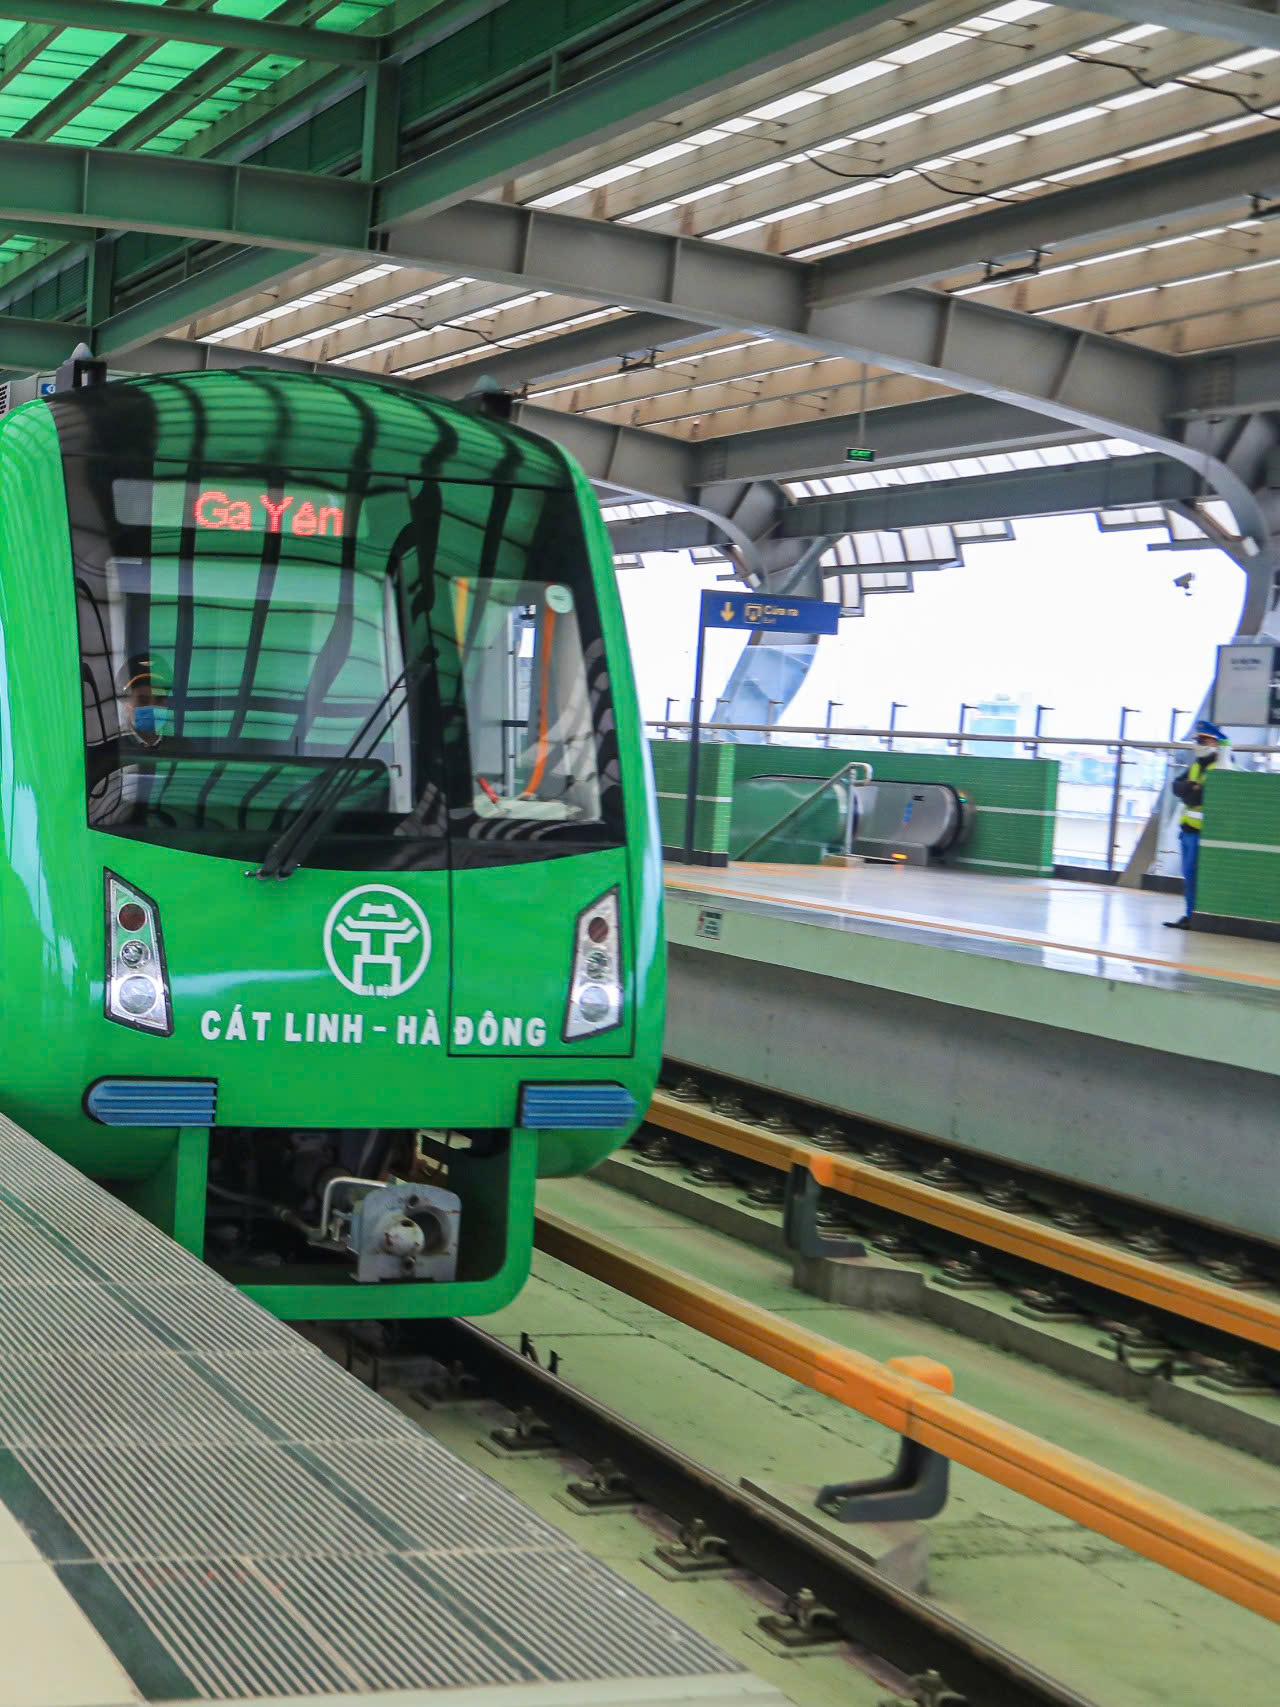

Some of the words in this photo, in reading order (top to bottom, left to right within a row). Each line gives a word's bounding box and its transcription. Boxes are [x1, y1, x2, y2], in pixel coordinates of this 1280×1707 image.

[194, 490, 252, 530] Ga
[259, 494, 344, 537] Yên
[200, 1003, 271, 1042] CÁT
[284, 1012, 364, 1044] LINH
[372, 1025, 387, 1033] -
[396, 1008, 441, 1046] HÀ
[453, 1009, 547, 1047] ĐÔNG
